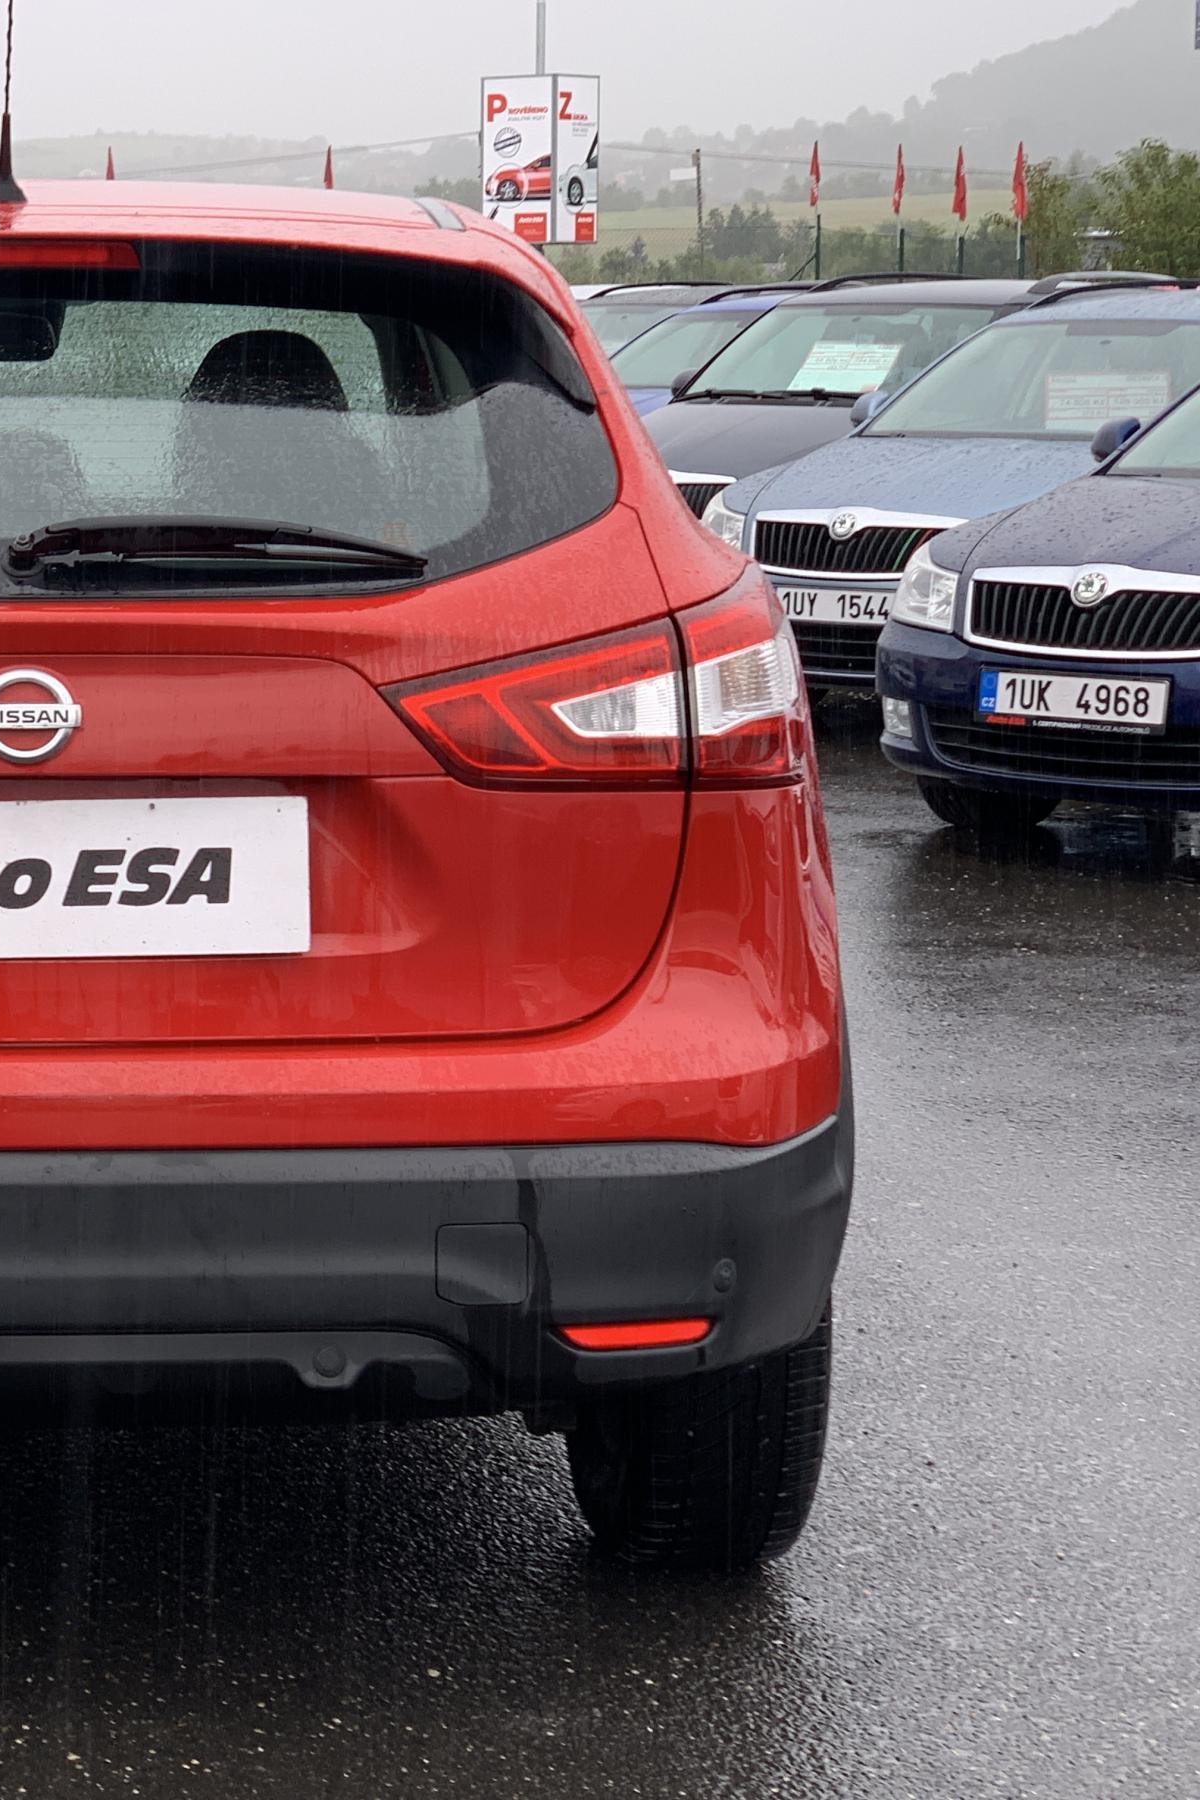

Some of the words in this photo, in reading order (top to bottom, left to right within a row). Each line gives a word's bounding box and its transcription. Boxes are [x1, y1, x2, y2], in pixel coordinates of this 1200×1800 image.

[782, 591, 818, 617] 1UY
[836, 594, 890, 620] 1544
[981, 697, 996, 707] CZ
[1005, 678, 1053, 711] 1UK
[1076, 684, 1150, 718] 4968
[61, 846, 234, 907] ESA
